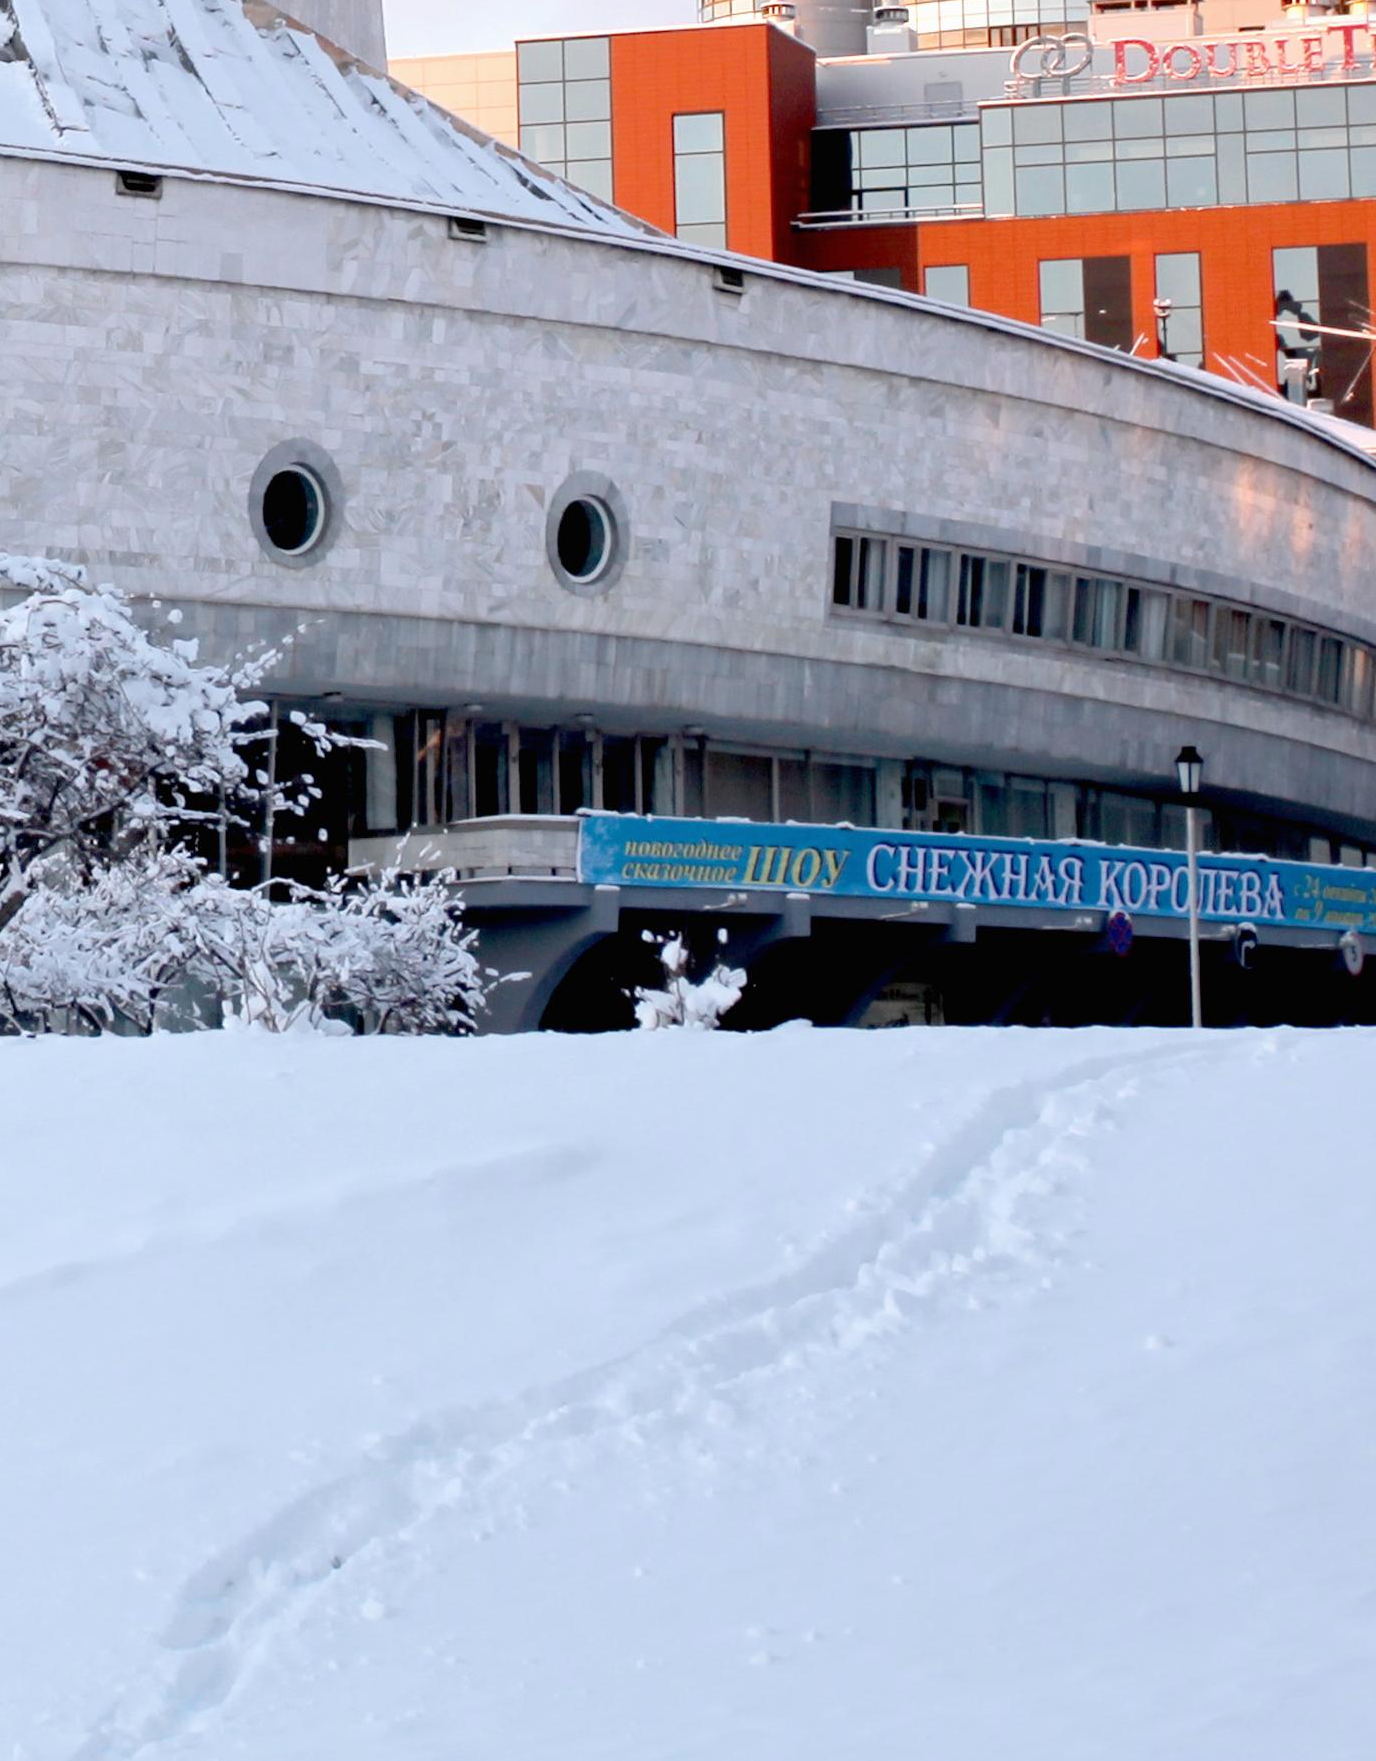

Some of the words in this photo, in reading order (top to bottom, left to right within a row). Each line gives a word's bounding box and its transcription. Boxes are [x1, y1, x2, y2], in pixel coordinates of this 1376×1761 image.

[1111, 24, 1376, 86] DOUBLET
[624, 838, 743, 861] новогоднее
[741, 845, 851, 888] ШОУ
[621, 860, 738, 883] сказочное
[866, 843, 1085, 905] СНЕЖНАЯ
[1097, 859, 1285, 920] КОРОЛЕВА
